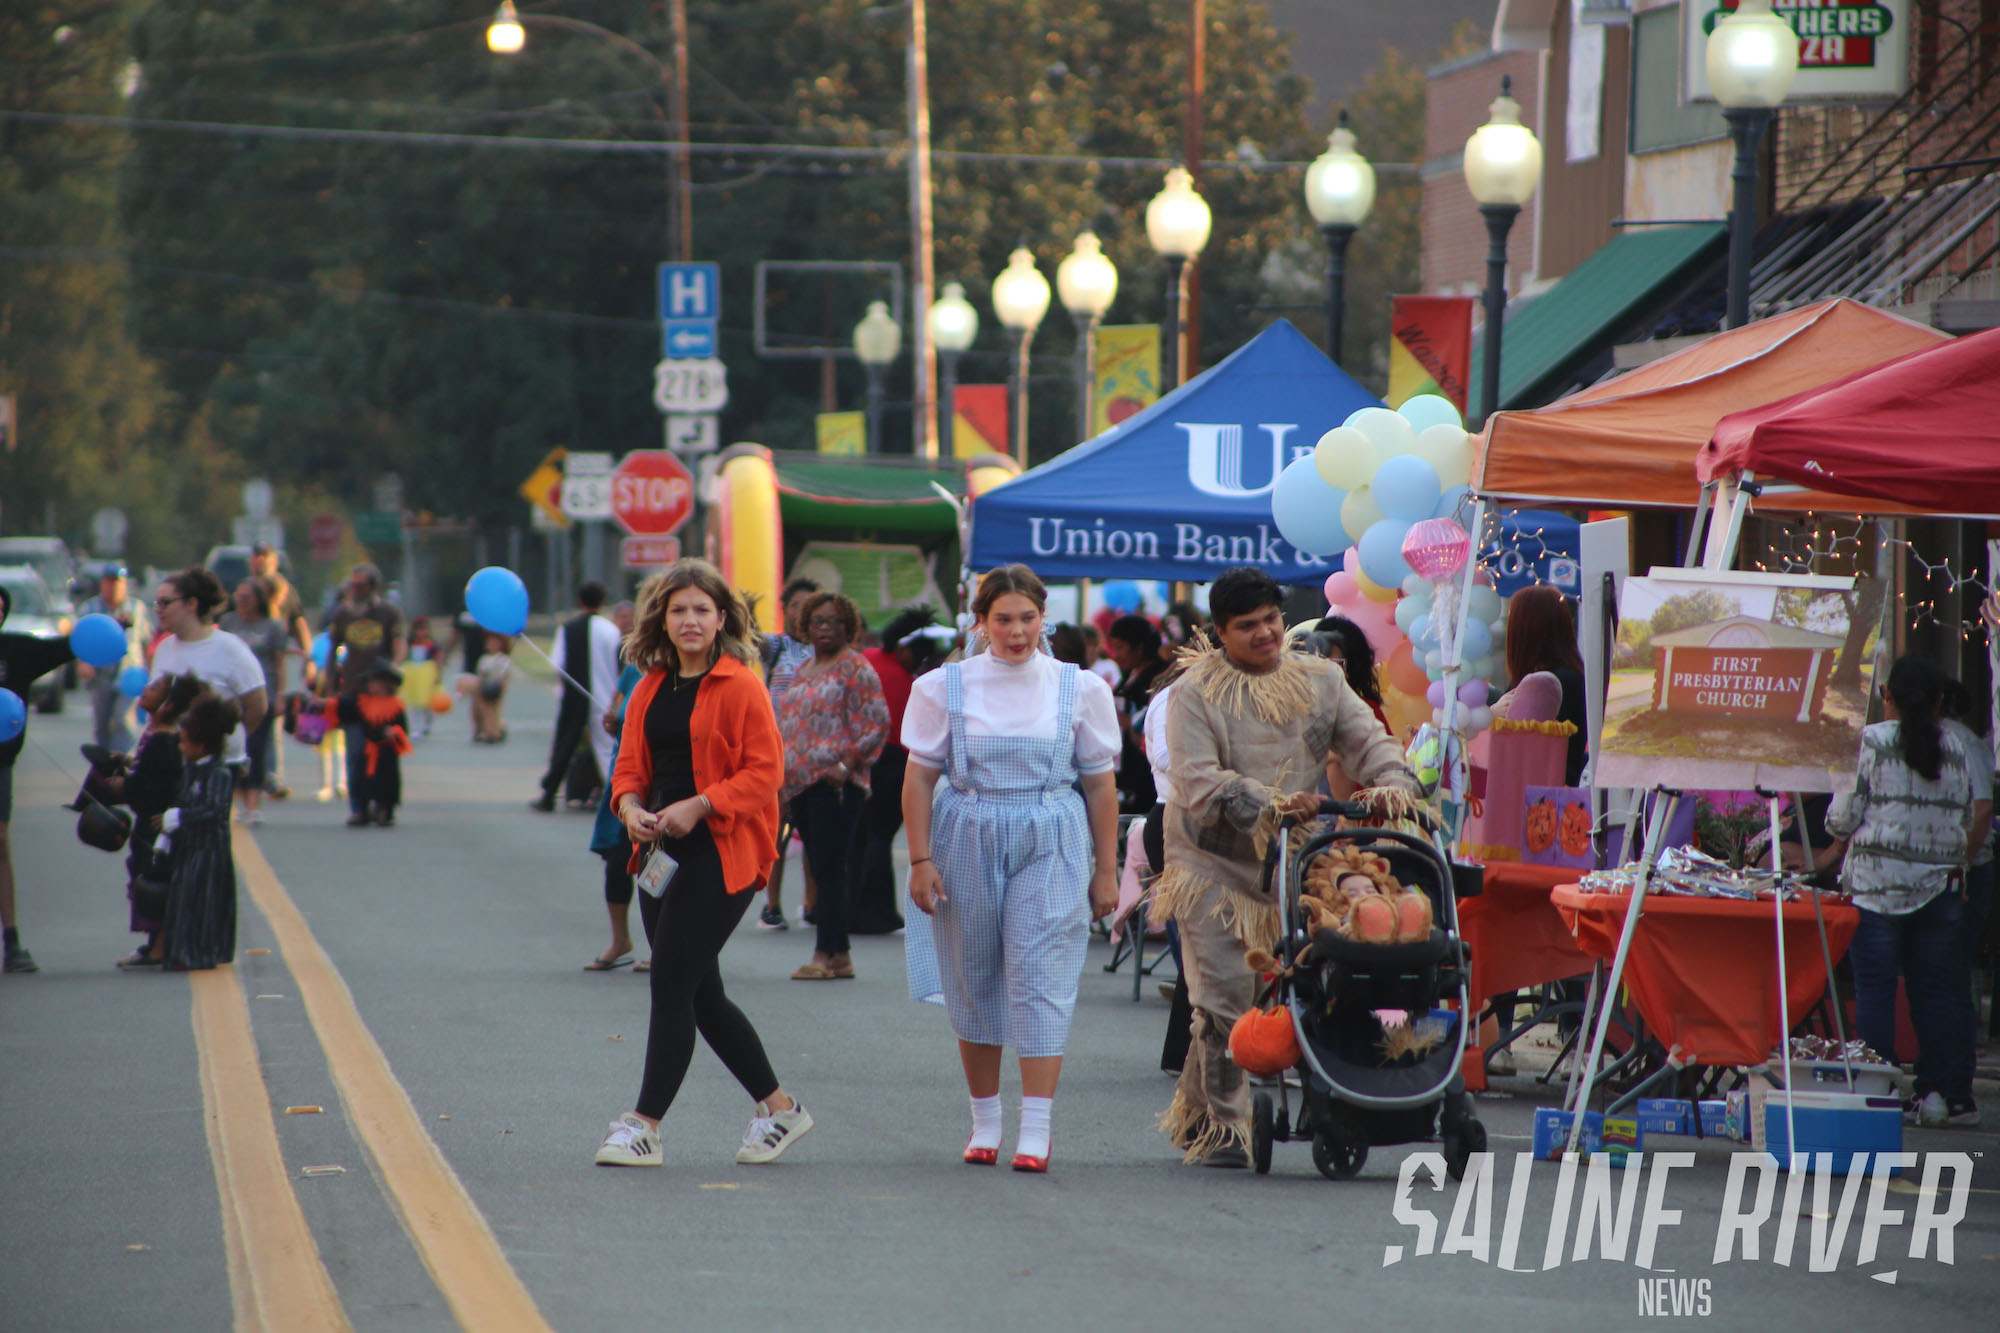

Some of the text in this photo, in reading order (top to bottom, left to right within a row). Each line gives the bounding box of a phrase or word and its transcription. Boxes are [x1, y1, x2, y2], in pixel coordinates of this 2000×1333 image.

[671, 271, 707, 315] H
[617, 477, 687, 512] STOP
[1028, 516, 1160, 556] Union
[1174, 523, 1283, 564] Bank
[1712, 657, 1762, 672] FIRST
[1673, 673, 1802, 692] PRESBYTERIAN
[1696, 691, 1767, 708] CHURCH
